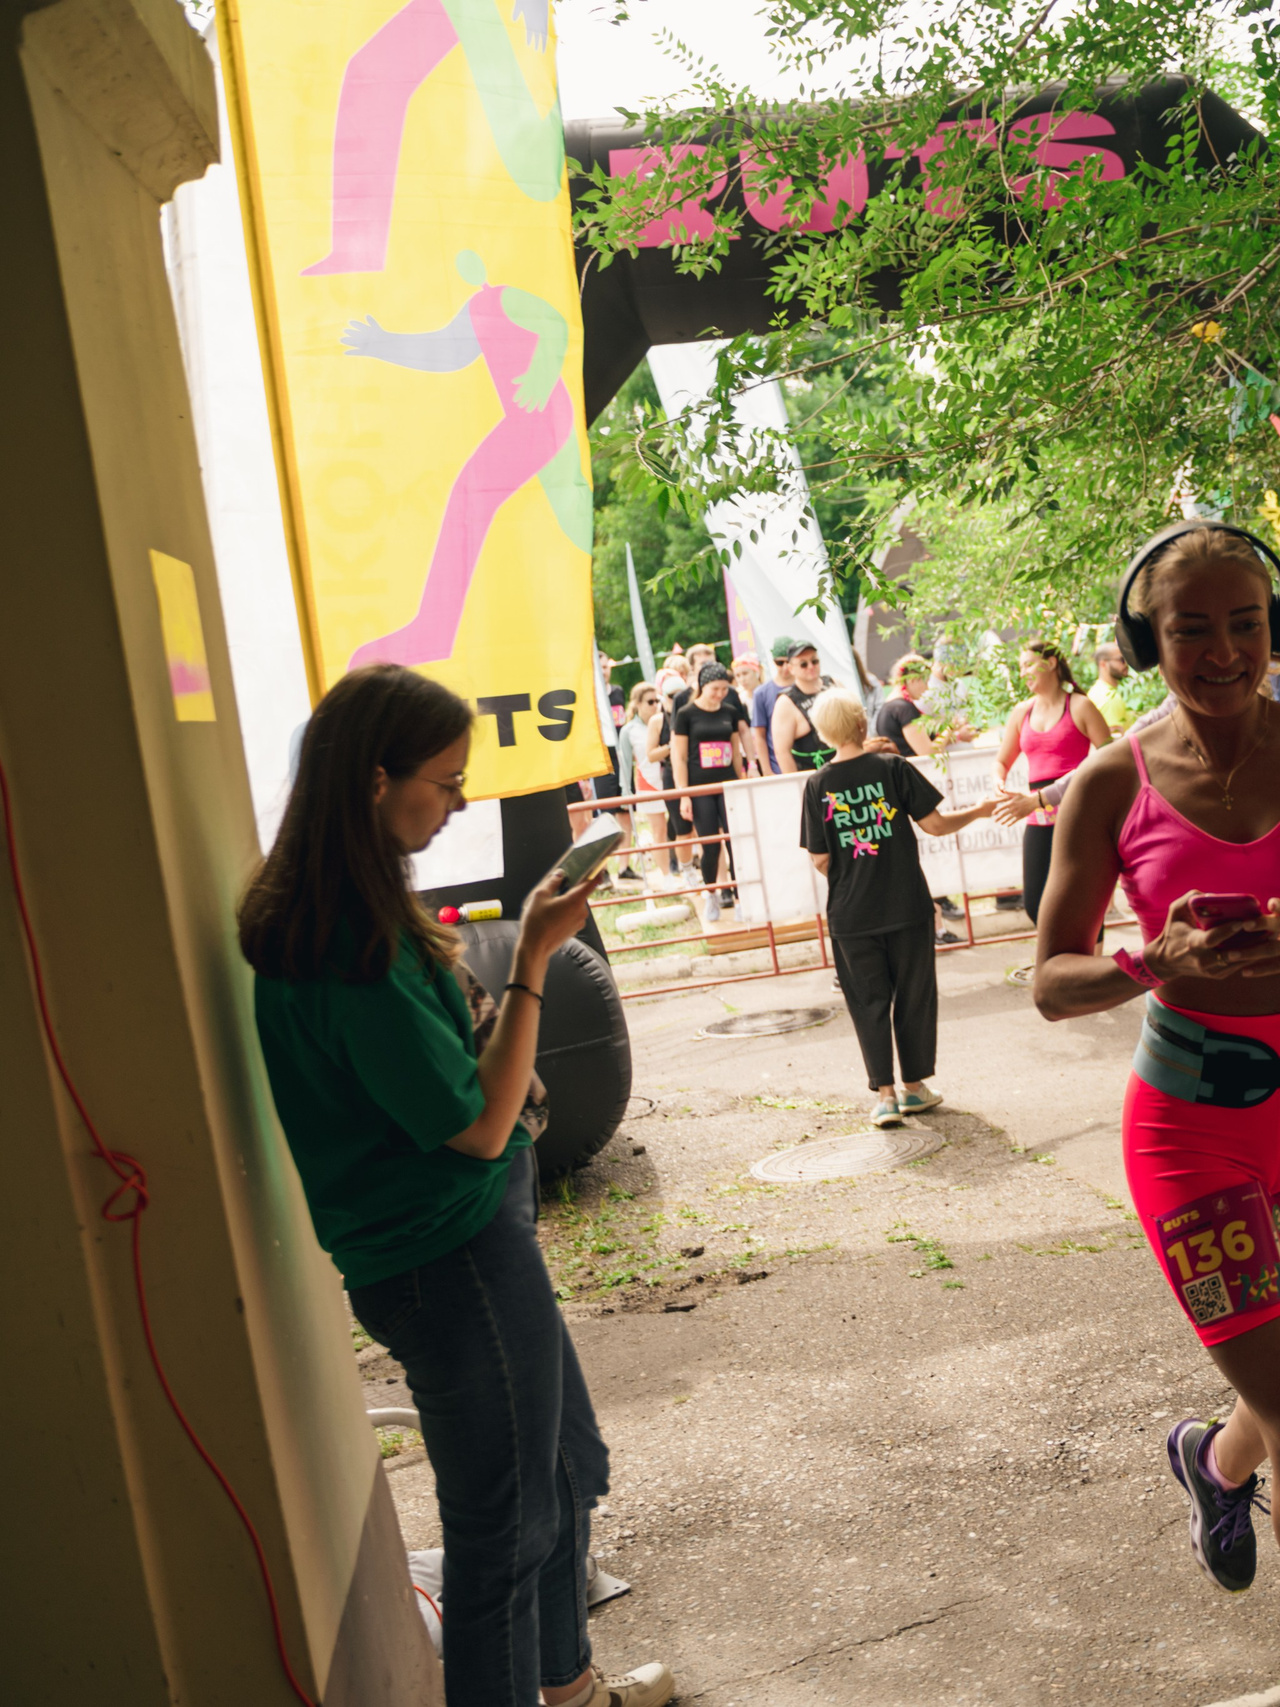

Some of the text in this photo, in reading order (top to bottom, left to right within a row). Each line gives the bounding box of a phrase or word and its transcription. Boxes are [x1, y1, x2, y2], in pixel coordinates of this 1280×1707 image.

[476, 689, 577, 748] TS
[829, 782, 885, 810] RUN
[833, 806, 886, 829] RUN
[838, 821, 893, 848] RUN
[1162, 1209, 1200, 1233] RUTS
[1166, 1220, 1255, 1281] 136
